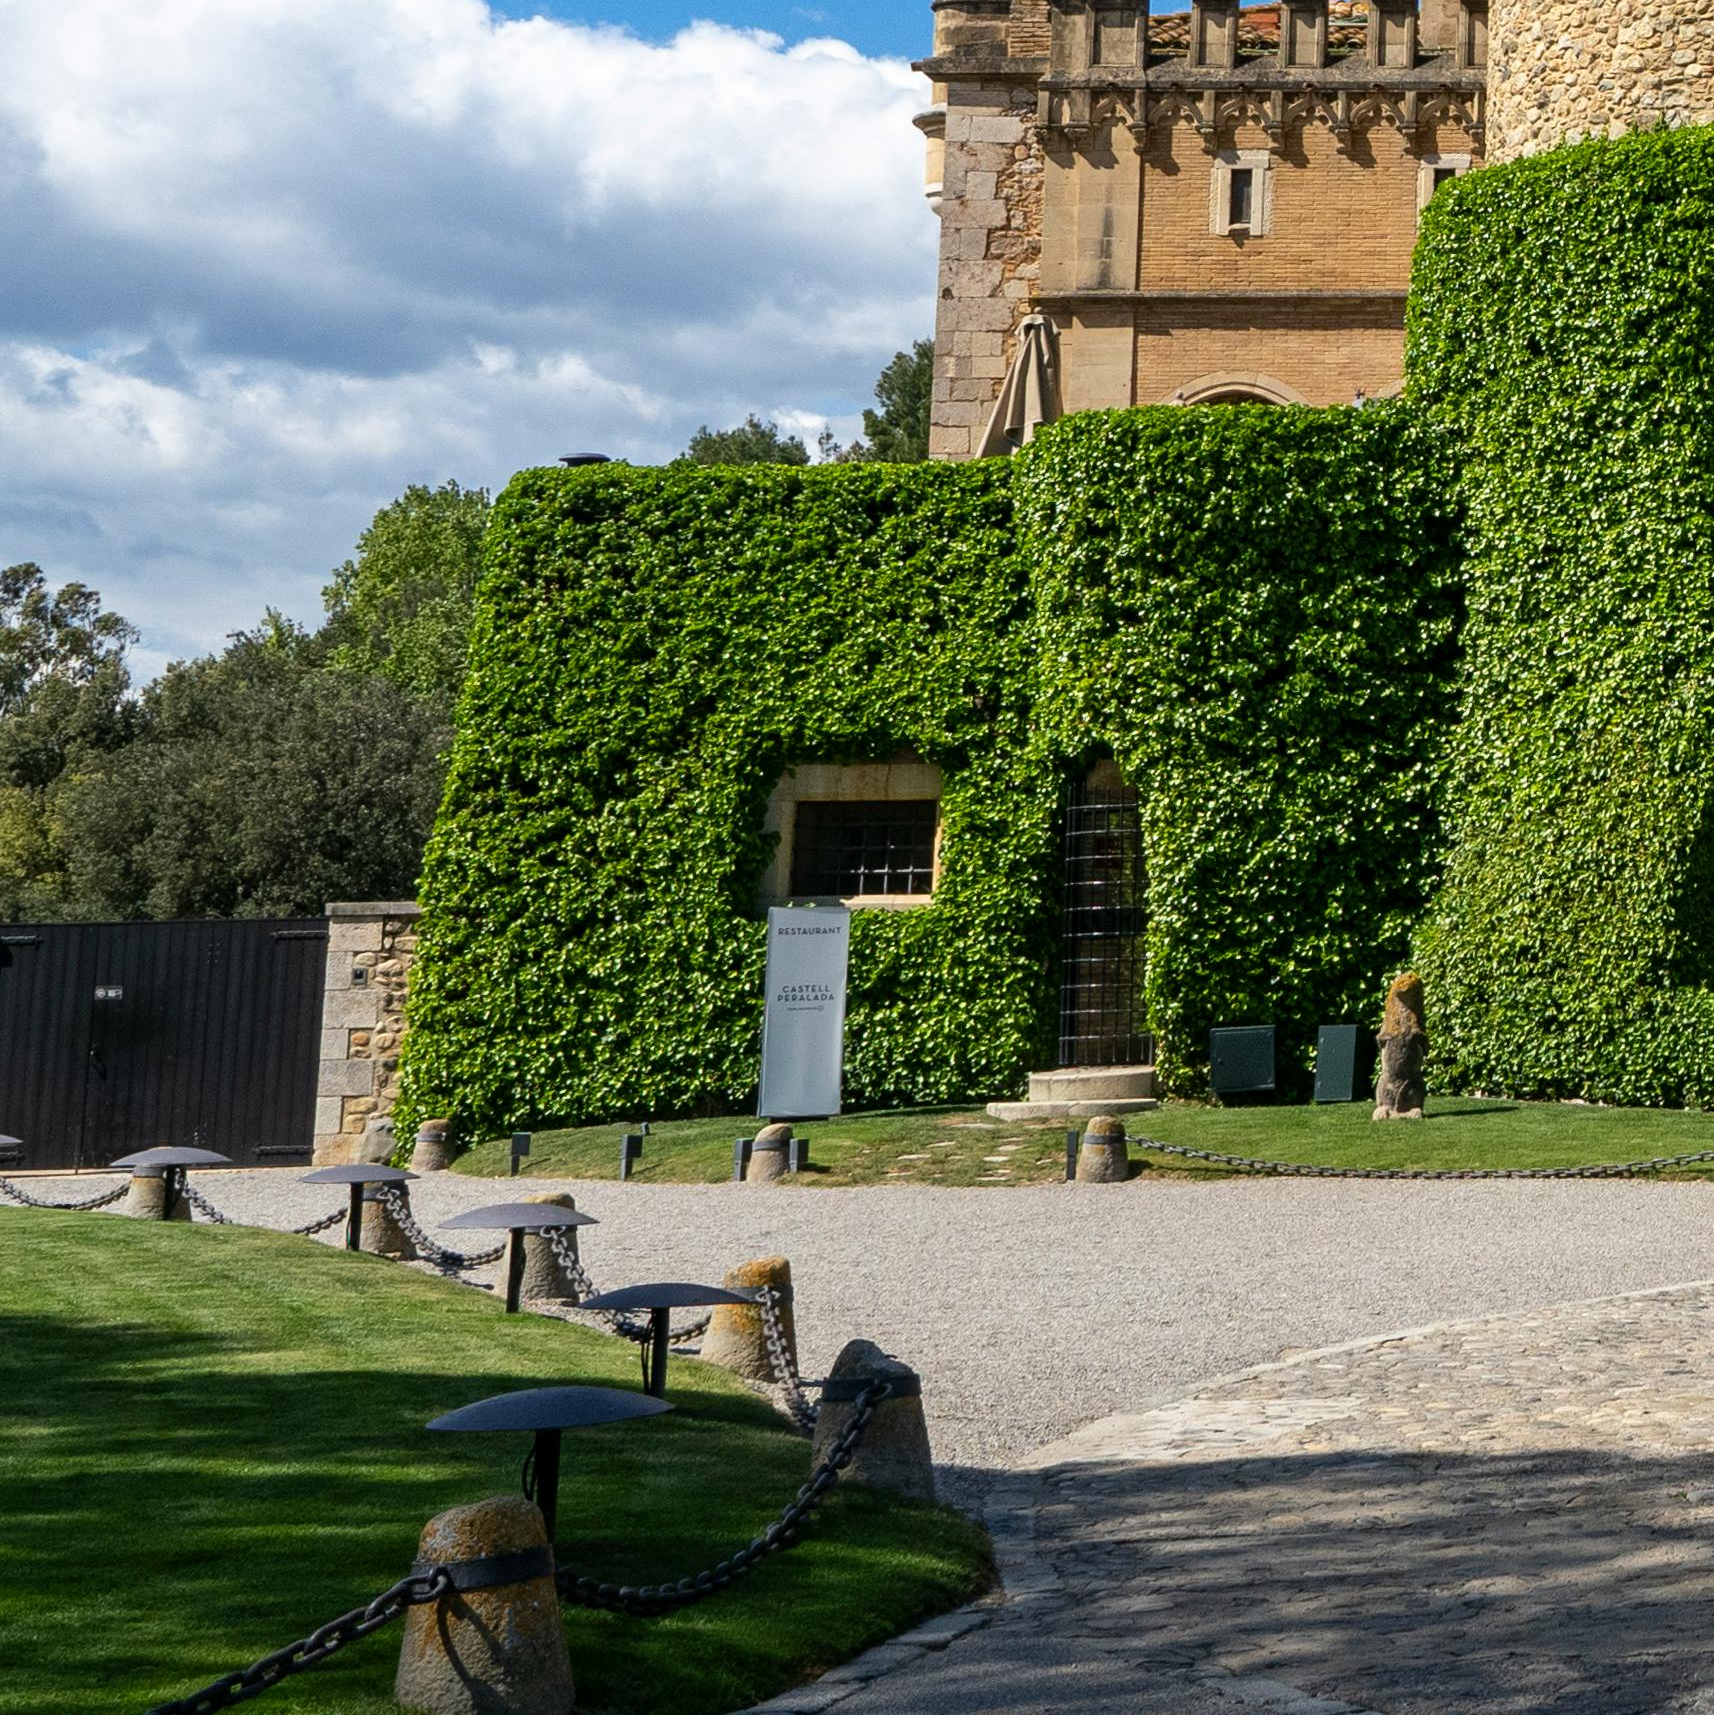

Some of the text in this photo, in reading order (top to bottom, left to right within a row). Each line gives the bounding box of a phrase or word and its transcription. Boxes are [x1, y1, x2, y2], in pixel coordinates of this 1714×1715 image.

[778, 927, 841, 935] RESTAURANT
[782, 985, 831, 993] CASTELL
[777, 993, 835, 1002] PERALADA
